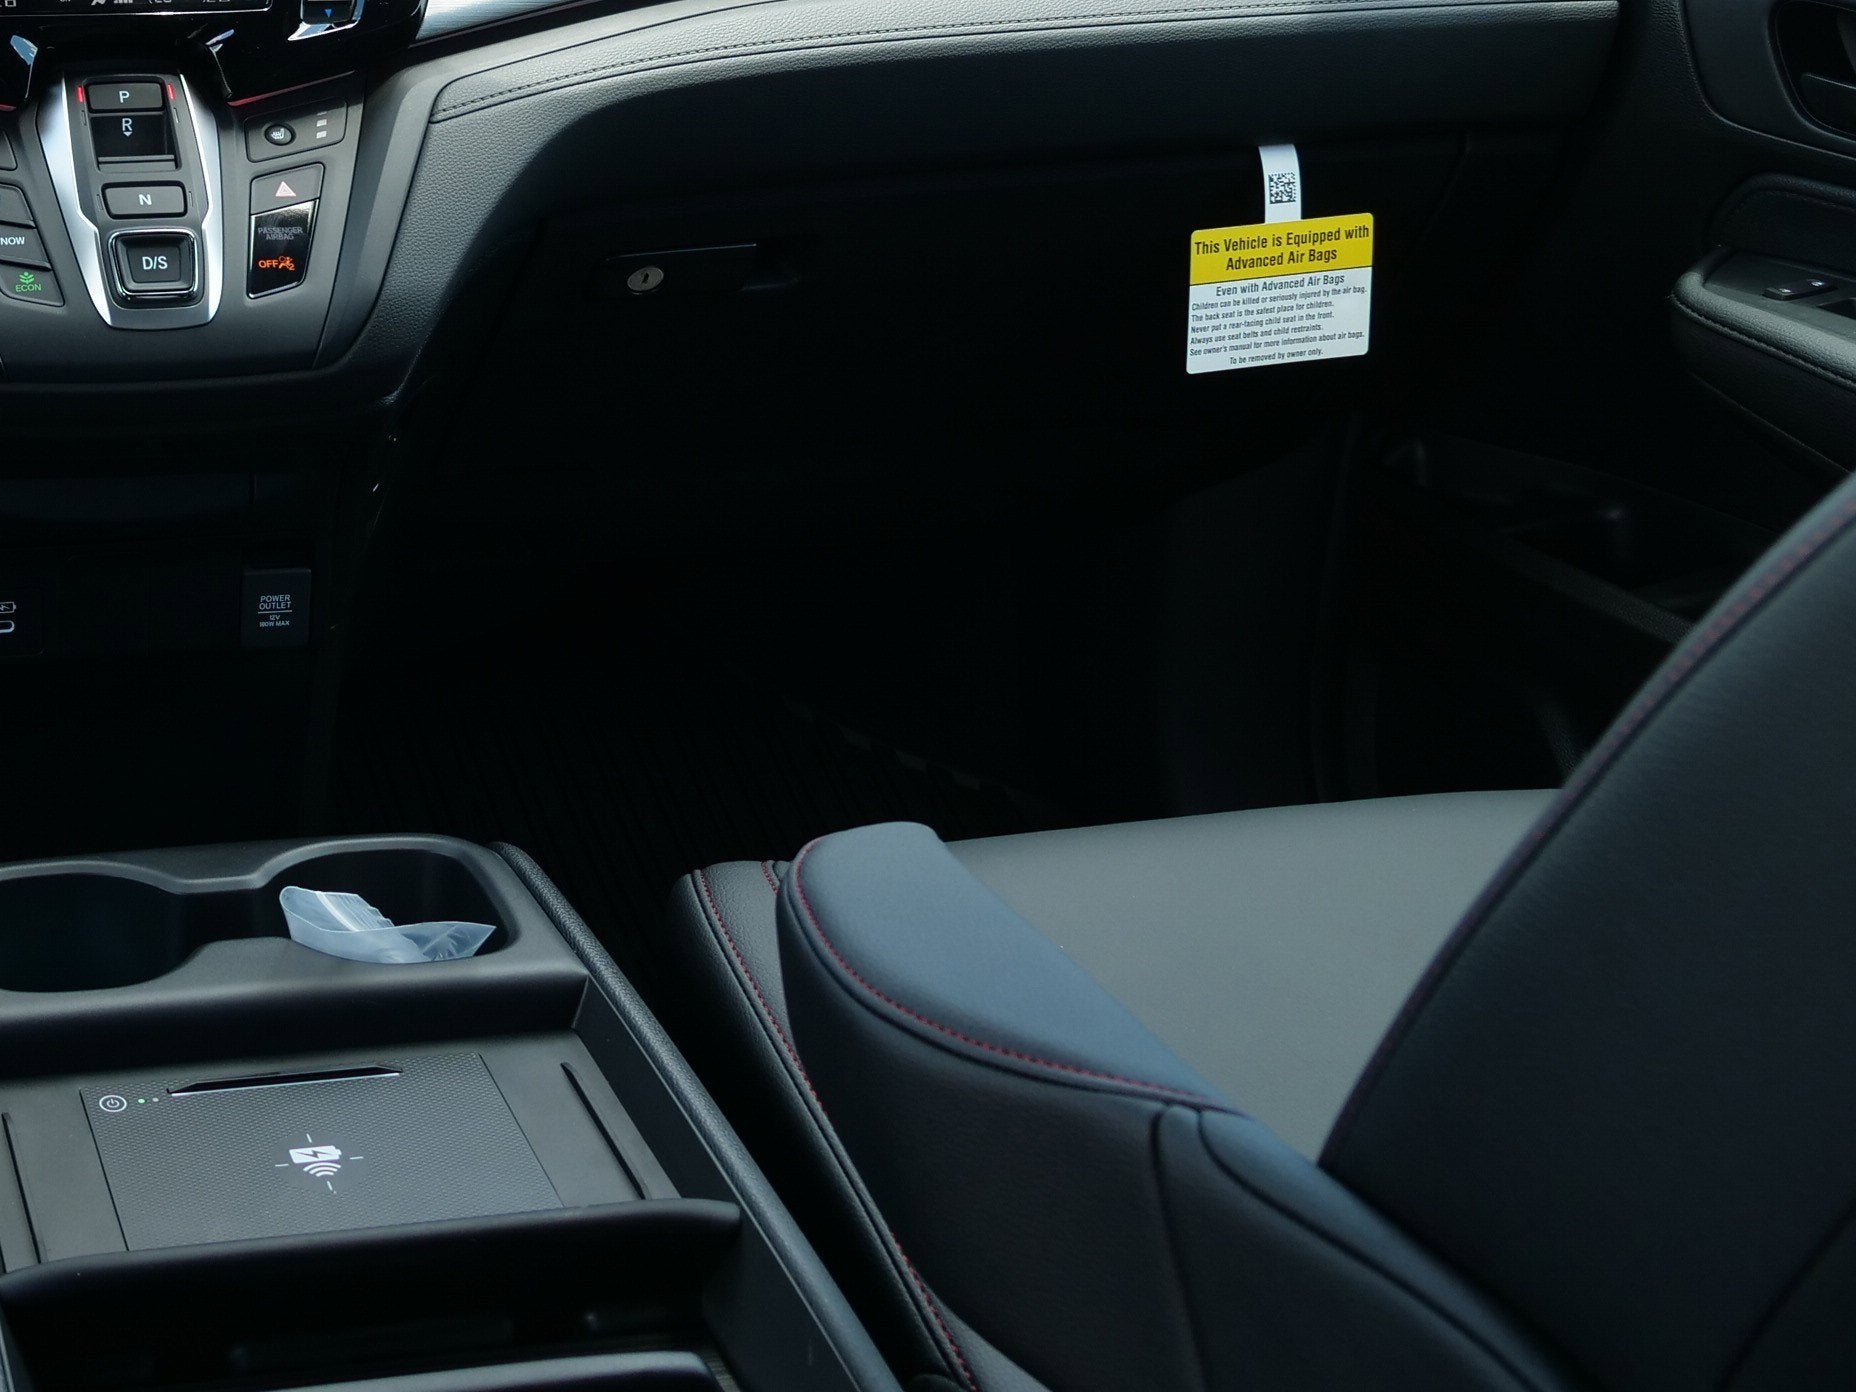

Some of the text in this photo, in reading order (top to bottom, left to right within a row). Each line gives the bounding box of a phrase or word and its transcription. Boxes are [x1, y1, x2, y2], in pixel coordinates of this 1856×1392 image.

[119, 90, 130, 103] P
[122, 118, 133, 131] R
[138, 194, 152, 206] N
[1195, 225, 1369, 255] This Vehicle is Equipped with
[142, 256, 168, 270] D/S
[258, 259, 279, 269] OFF
[1226, 249, 1337, 270] Advanced Air Bags
[15, 283, 42, 292] ECON
[1216, 275, 1345, 296] Even with Advanced Air Bags
[1248, 352, 1276, 362] removed
[1278, 352, 1285, 360] by
[1287, 350, 1306, 358] owner
[1308, 348, 1323, 356] only.
[260, 594, 291, 602] POWER
[259, 601, 291, 610] OUTLET
